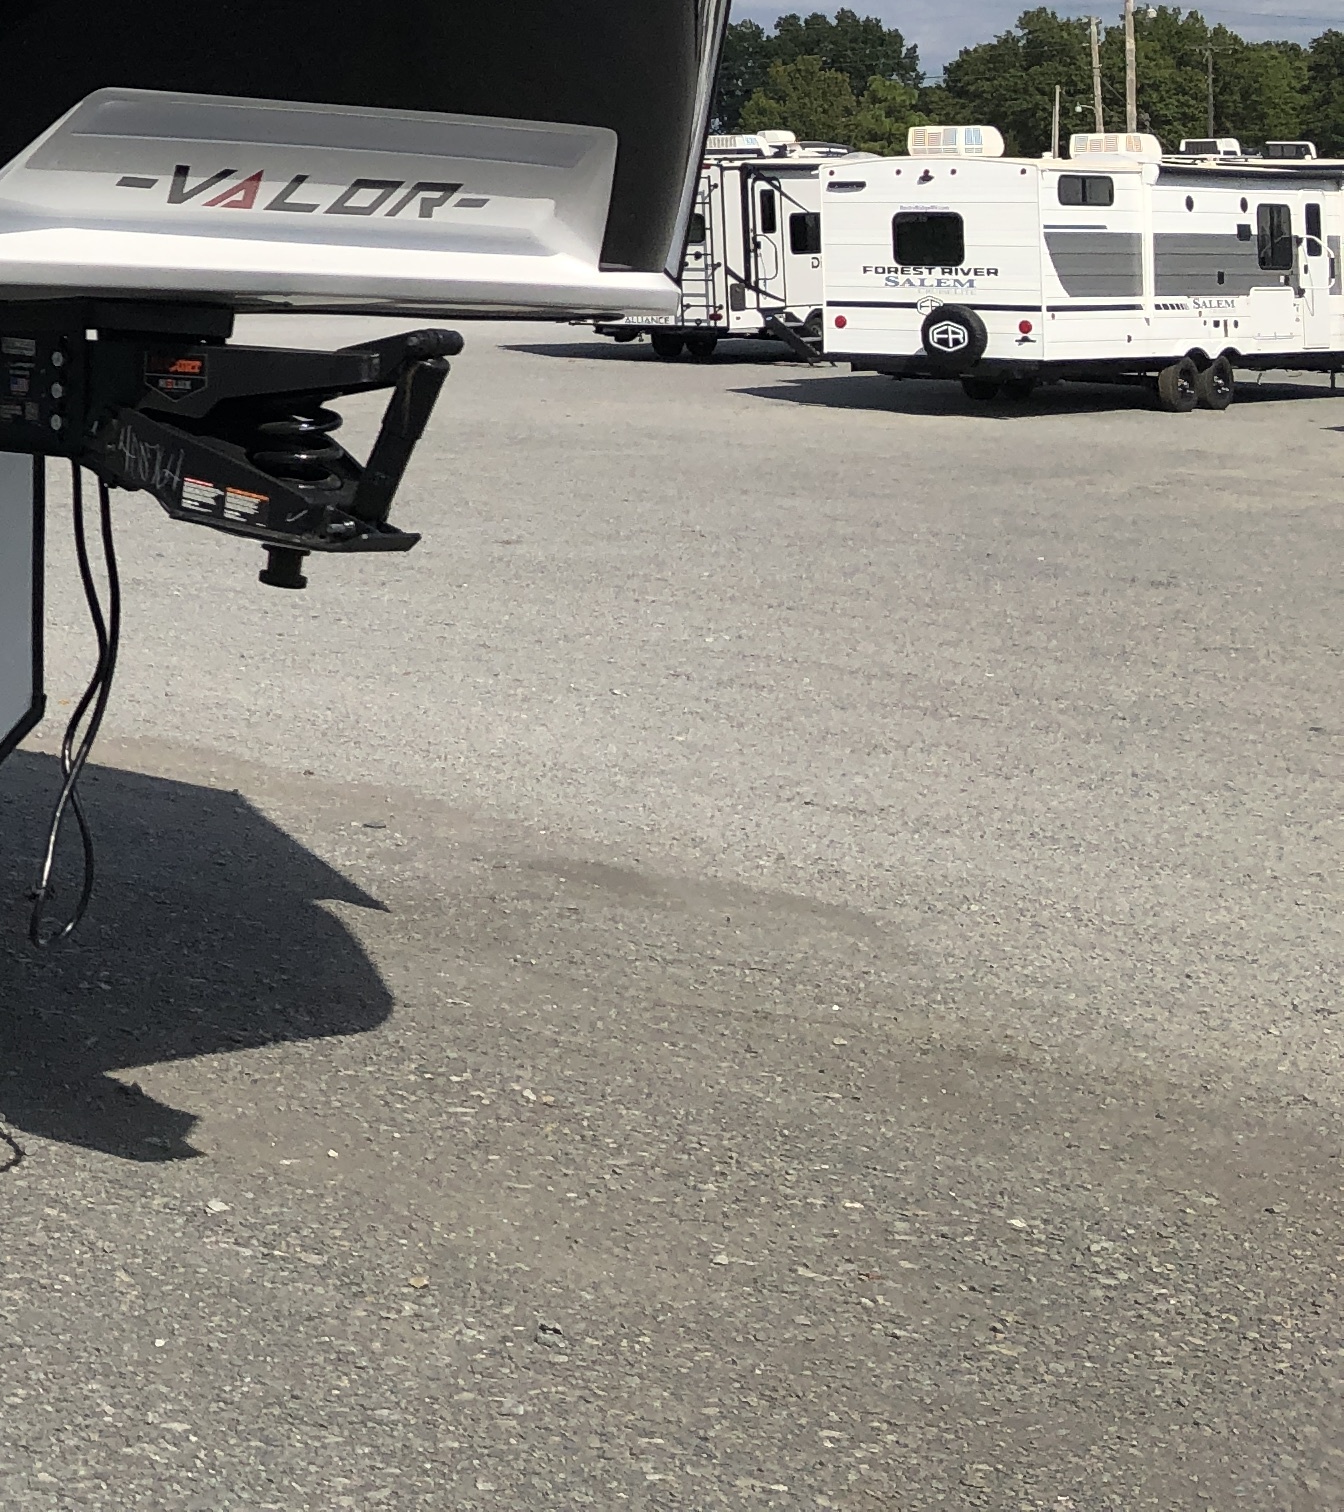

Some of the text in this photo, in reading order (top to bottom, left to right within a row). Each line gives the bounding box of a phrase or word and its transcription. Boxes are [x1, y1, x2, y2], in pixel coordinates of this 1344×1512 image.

[862, 265, 999, 277] FOREST RIVER
[624, 315, 671, 325] ALLIANCE
